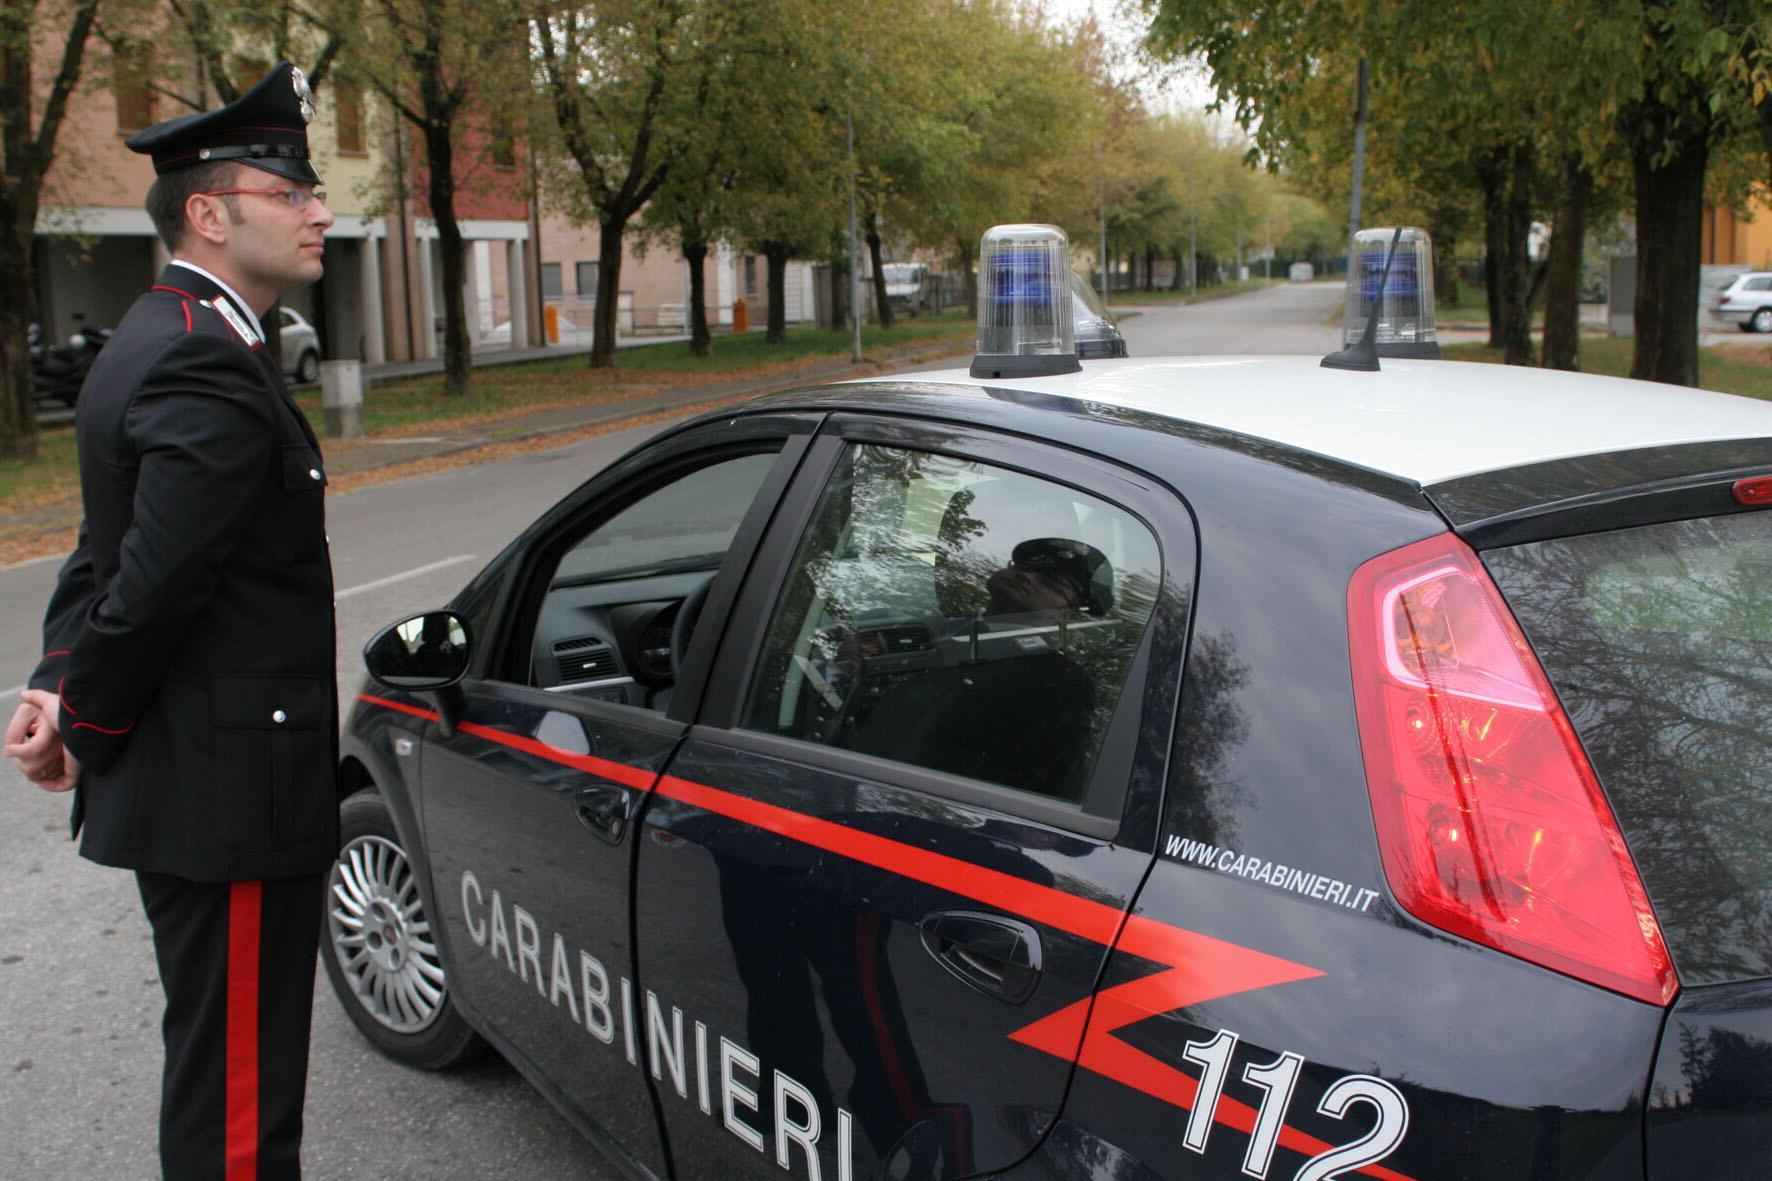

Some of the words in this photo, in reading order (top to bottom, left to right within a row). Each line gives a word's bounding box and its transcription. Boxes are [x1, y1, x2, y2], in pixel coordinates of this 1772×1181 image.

[1165, 834, 1379, 912] WWW.CARABINIERI.IT
[461, 870, 853, 1181] CARABINIERI
[1182, 1028, 1410, 1181] 112
